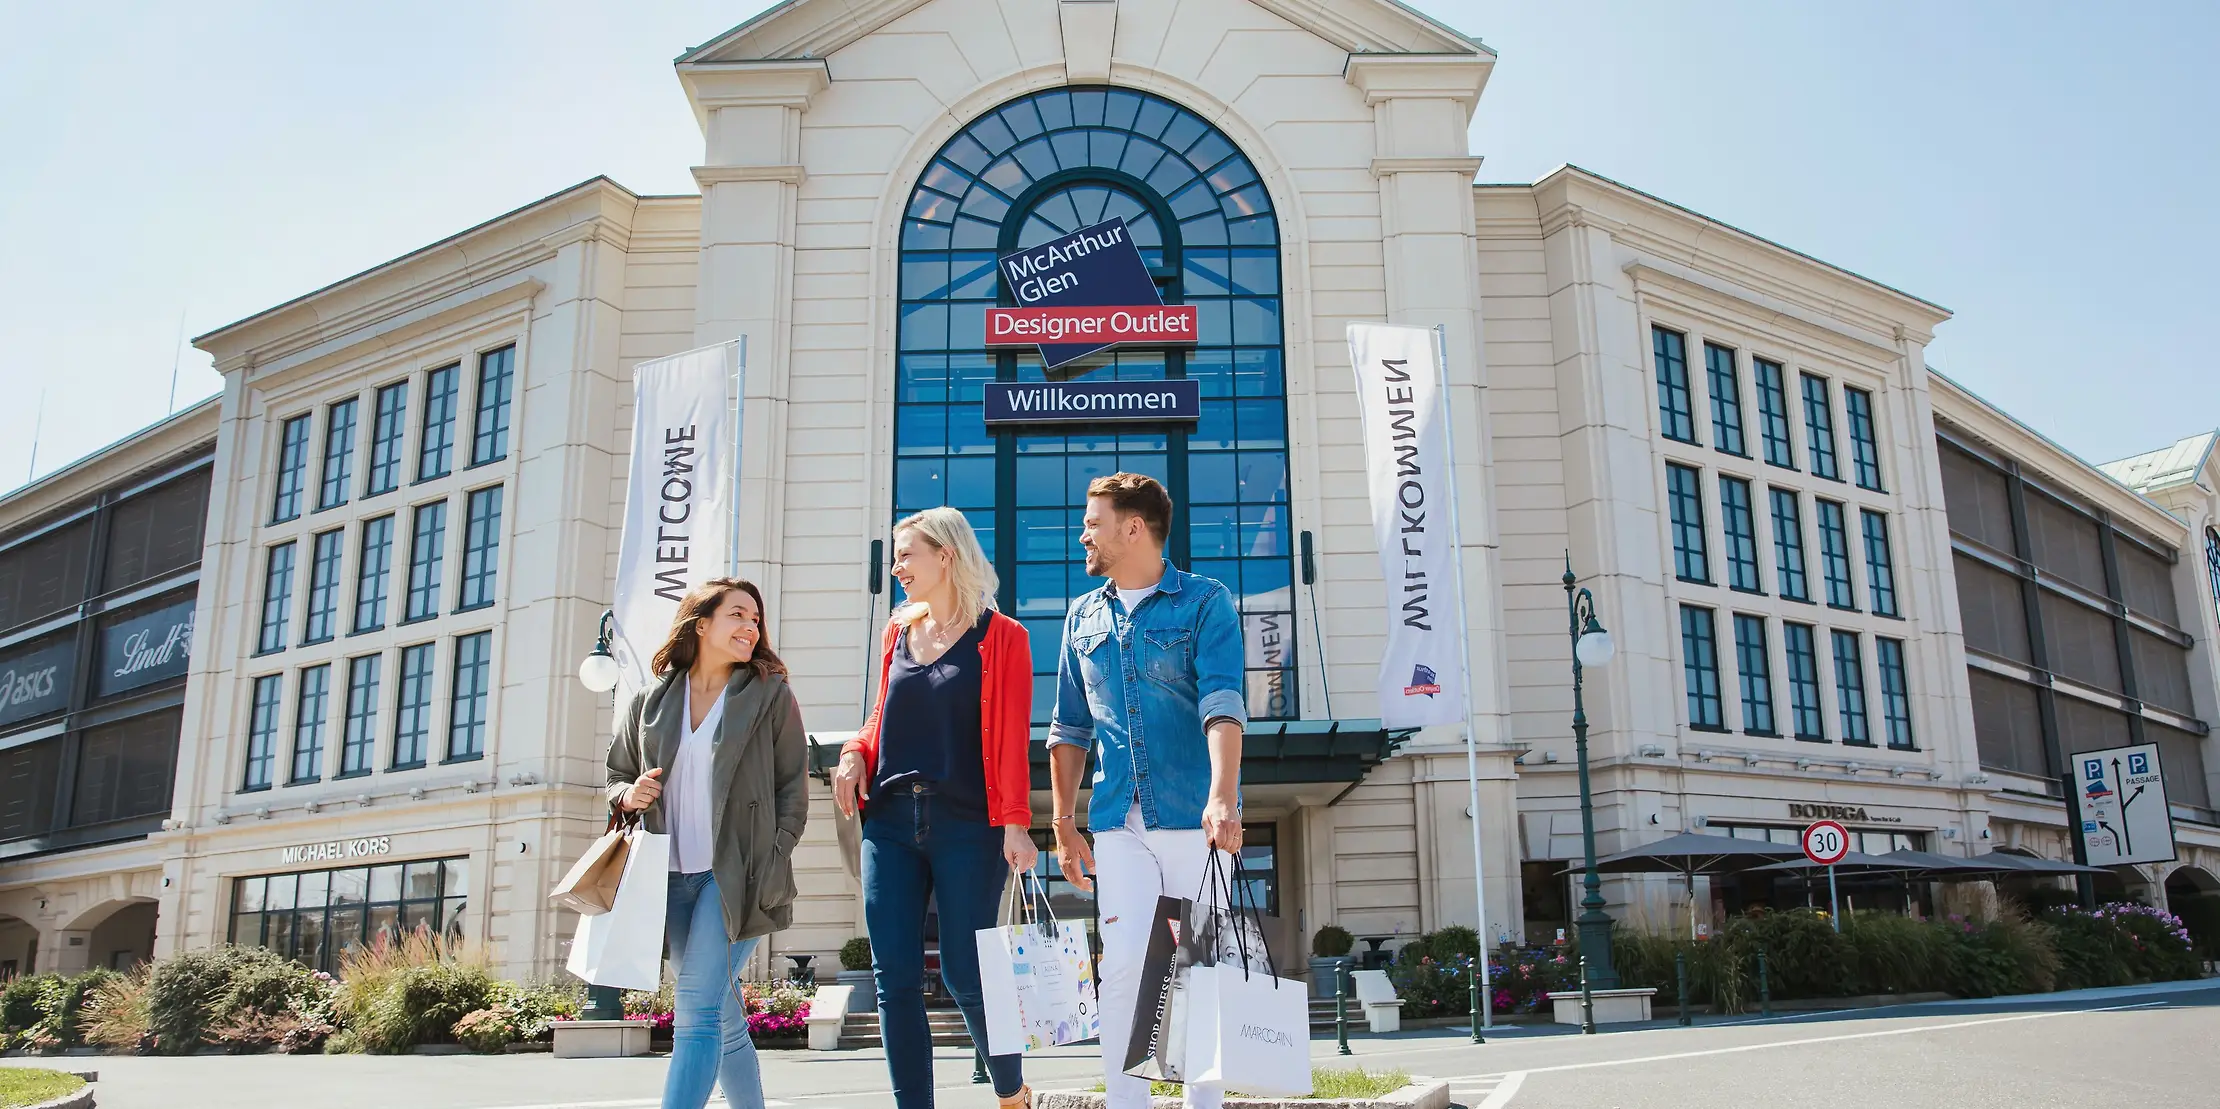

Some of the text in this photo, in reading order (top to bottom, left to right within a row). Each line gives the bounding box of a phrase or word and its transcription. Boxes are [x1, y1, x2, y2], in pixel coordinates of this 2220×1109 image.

[1007, 225, 1123, 281] McArthur
[1019, 269, 1079, 302] Glen
[994, 311, 1190, 340] Designer Outlet
[1007, 387, 1177, 412] Willkommen
[114, 622, 183, 677] Lindt
[2126, 775, 2160, 785] PASSAGE
[1788, 803, 1869, 821] BODEGA
[282, 836, 390, 864] MICHAEL KORS
[1814, 832, 1837, 853] 30
[1148, 1023, 1161, 1057] SHOP
